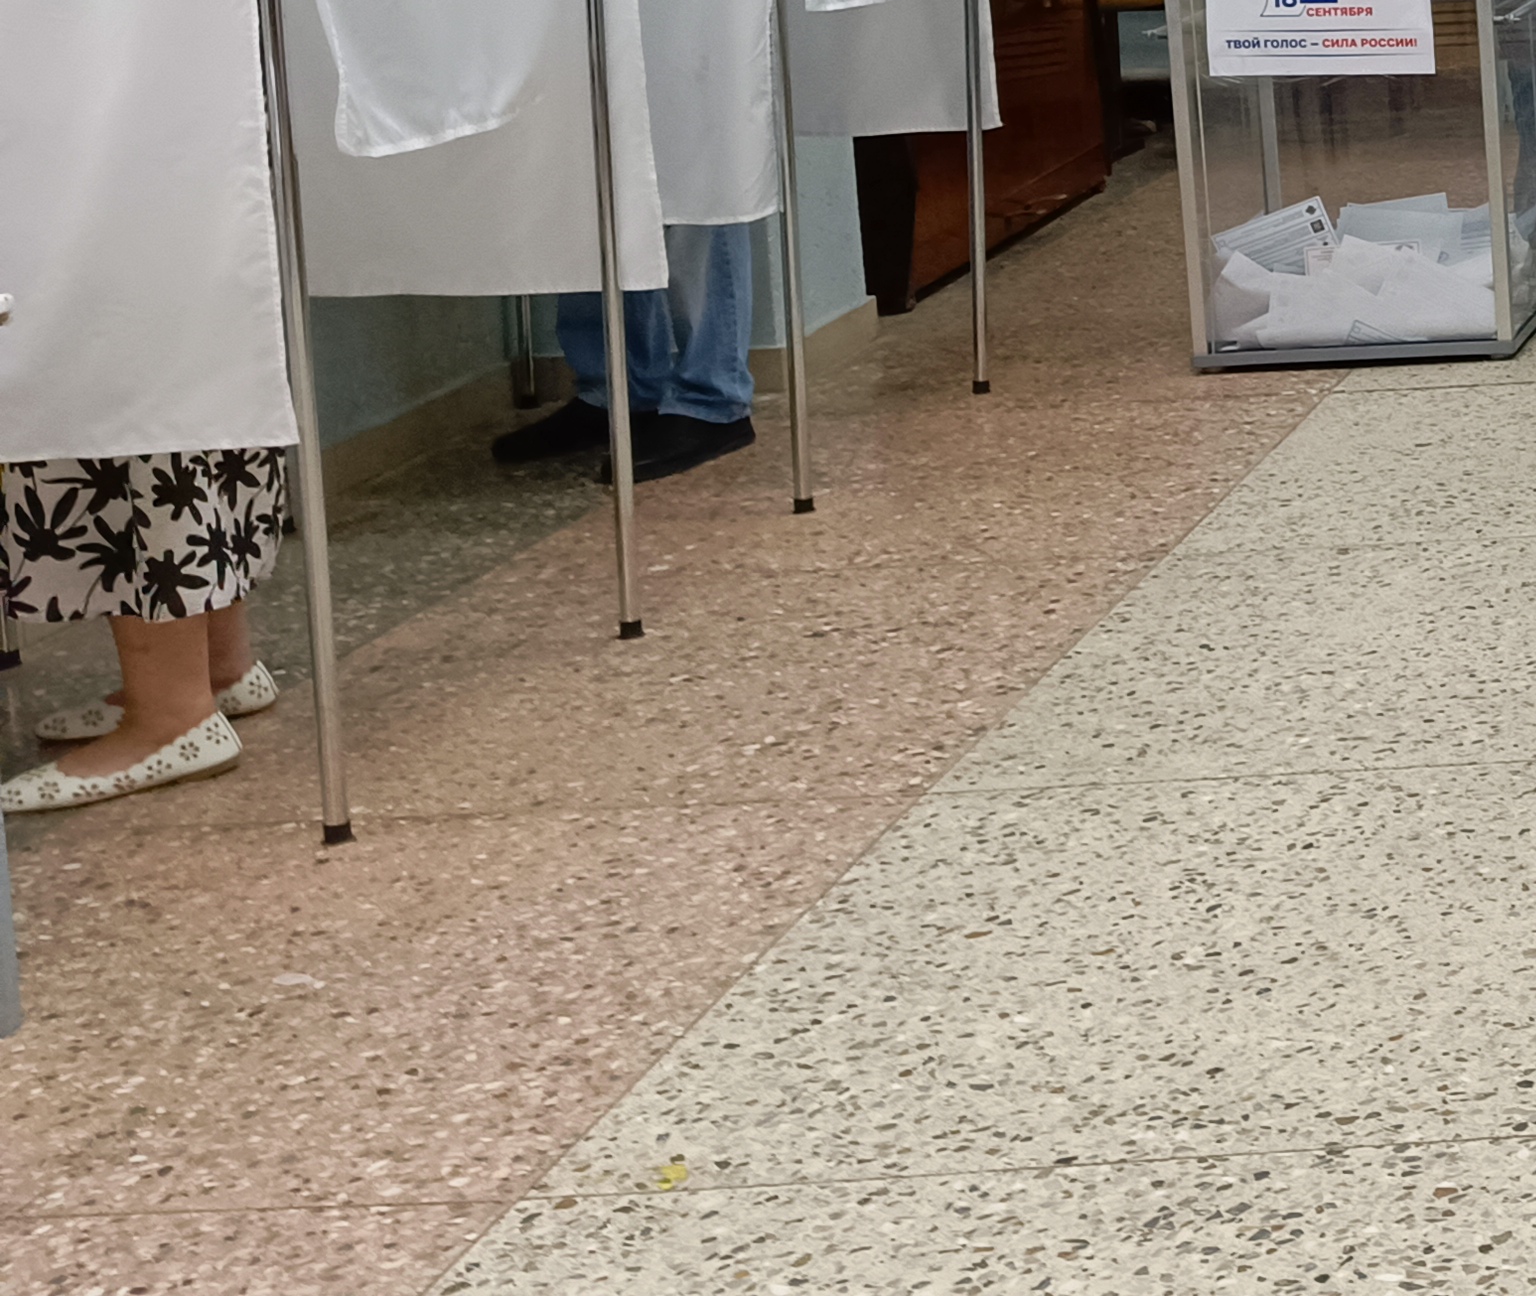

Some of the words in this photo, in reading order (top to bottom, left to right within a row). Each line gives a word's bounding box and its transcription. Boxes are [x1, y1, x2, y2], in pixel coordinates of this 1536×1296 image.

[1306, 7, 1373, 17] СЕНТЯБРЯ
[1225, 37, 1261, 49] ТВОЙ
[1264, 39, 1307, 49] ГОЛОС
[1322, 38, 1357, 49] СИЛА
[1361, 38, 1418, 48] РОССИИ!
